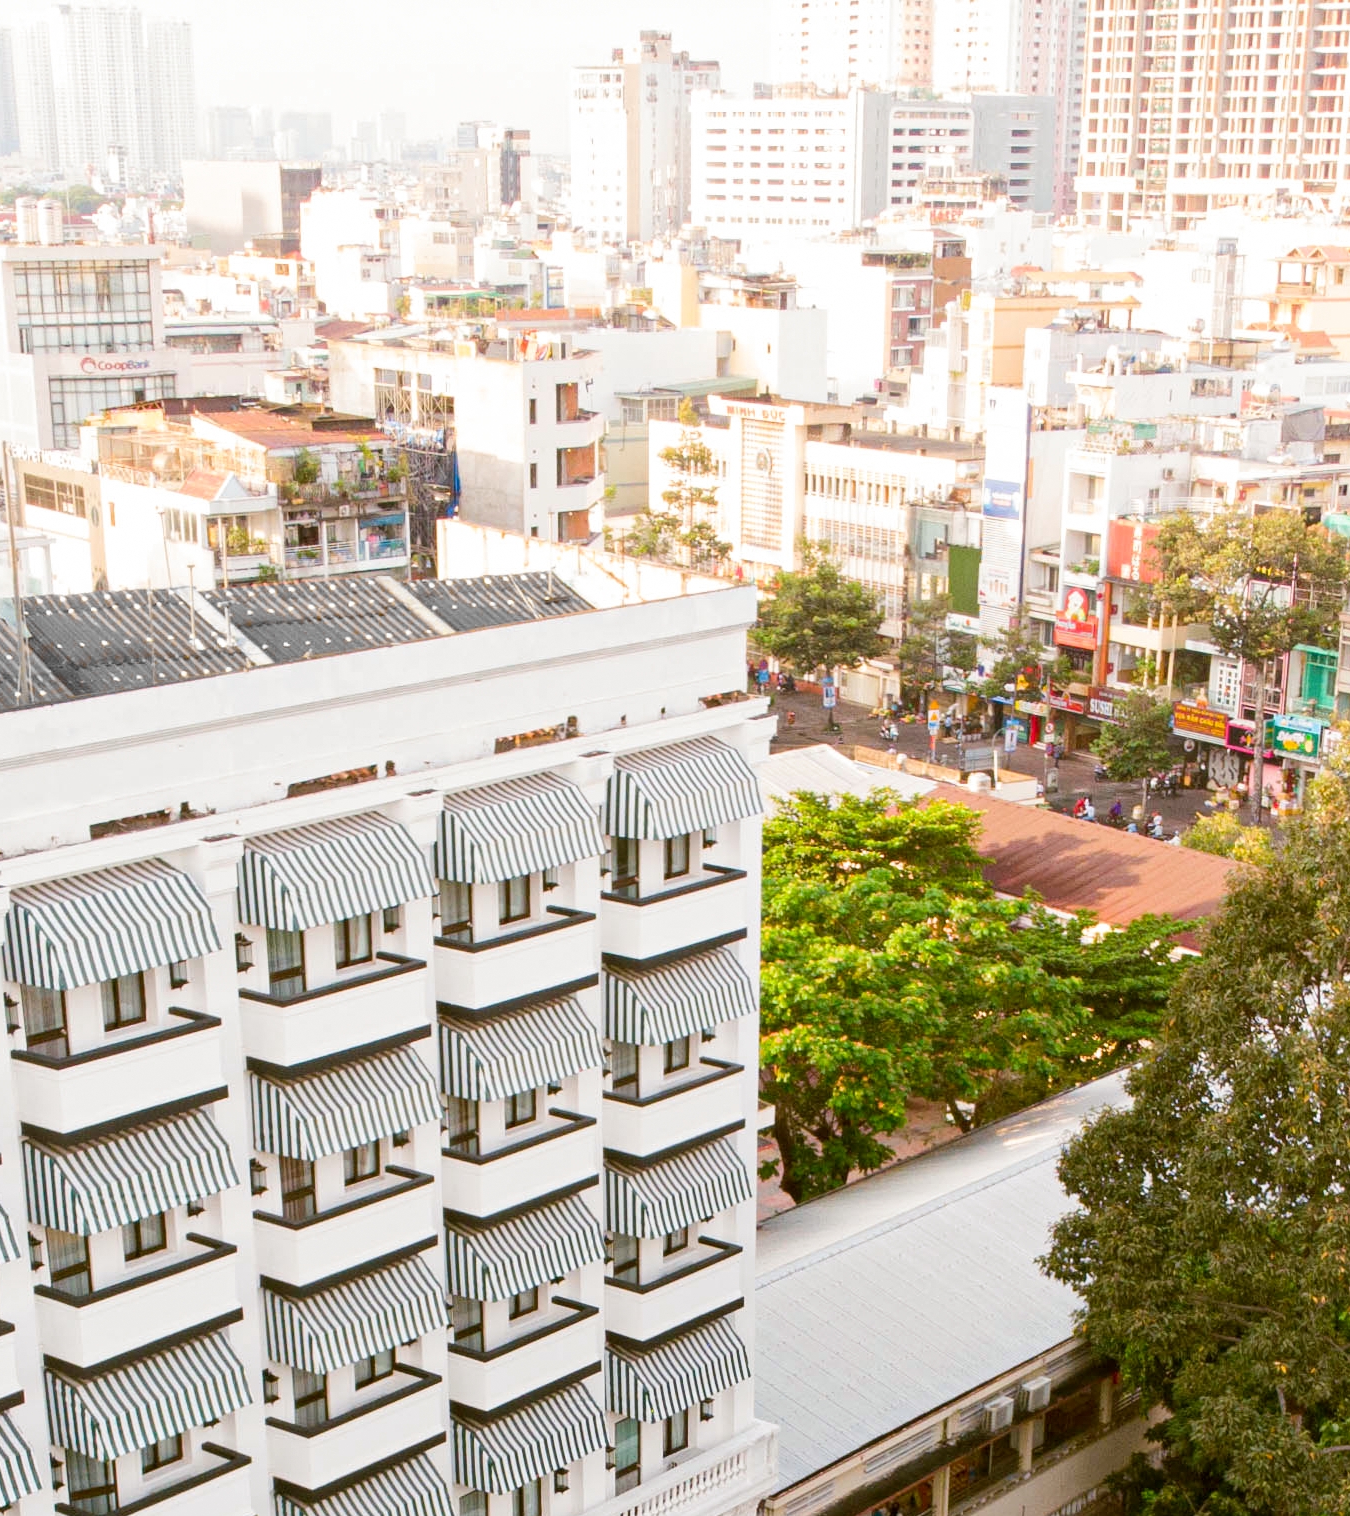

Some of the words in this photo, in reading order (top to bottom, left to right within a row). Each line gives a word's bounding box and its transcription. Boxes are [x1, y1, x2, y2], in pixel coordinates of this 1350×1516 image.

[98, 359, 150, 372] Co-opBank
[727, 405, 756, 417] MINH
[1090, 698, 1114, 717] SUSHI
